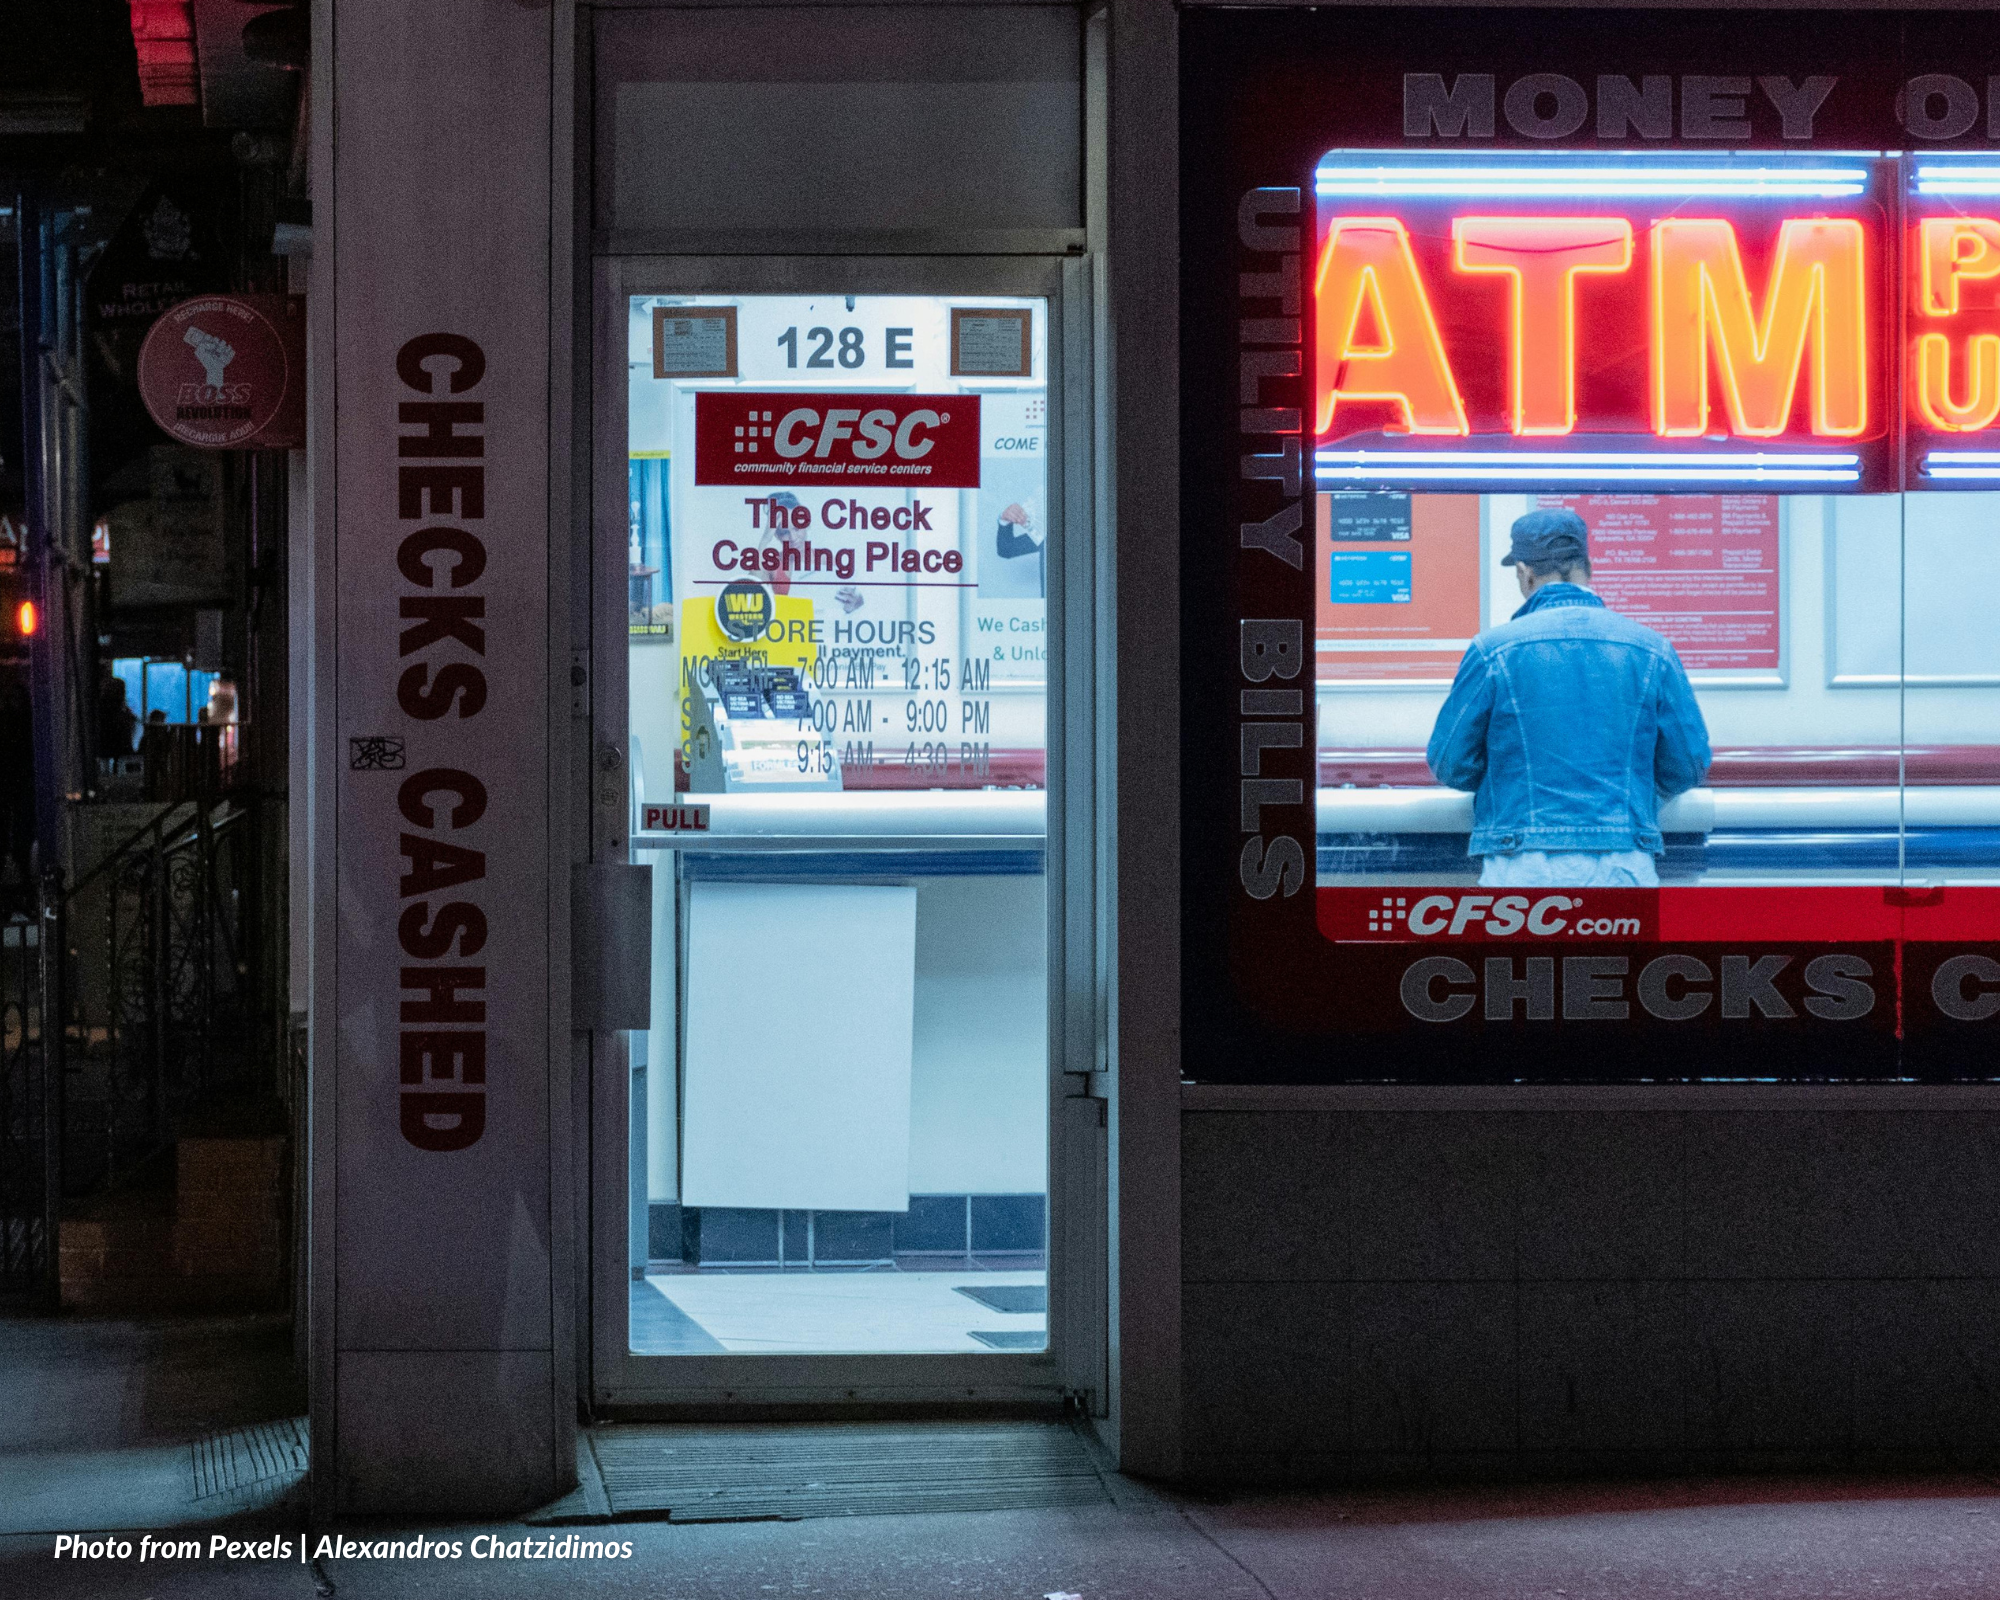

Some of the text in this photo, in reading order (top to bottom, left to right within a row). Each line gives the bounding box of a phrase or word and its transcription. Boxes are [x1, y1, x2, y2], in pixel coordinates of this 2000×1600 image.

[1402, 72, 2000, 140] MONEY O
[1315, 216, 1868, 438] ATM
[776, 326, 865, 369] 128
[885, 327, 914, 369] E
[176, 382, 253, 405] BOSS
[176, 405, 253, 421] REVOLUTION
[994, 437, 1039, 451] COME
[734, 461, 933, 476] community financial service centers
[744, 498, 933, 531] The Check
[712, 539, 964, 580] Cashing Place
[1237, 186, 1305, 900] UTILITY BILLS
[726, 618, 936, 645] STORE HOURS
[977, 616, 1004, 632] We
[718, 646, 768, 659] Start Here
[831, 644, 907, 661] payment.
[992, 645, 1006, 661] &
[797, 656, 838, 690] 7:00
[844, 655, 875, 690] AM
[901, 657, 951, 691] 12:15
[960, 657, 990, 691] AM
[843, 699, 872, 733] AM
[906, 699, 948, 733] 9:00
[962, 700, 990, 734] PM
[396, 332, 488, 1153] CHECKS CASHED
[797, 739, 833, 774] 9:15
[960, 741, 990, 777] PM
[646, 808, 707, 830] PULL
[1400, 954, 1877, 1023] CHECKS
